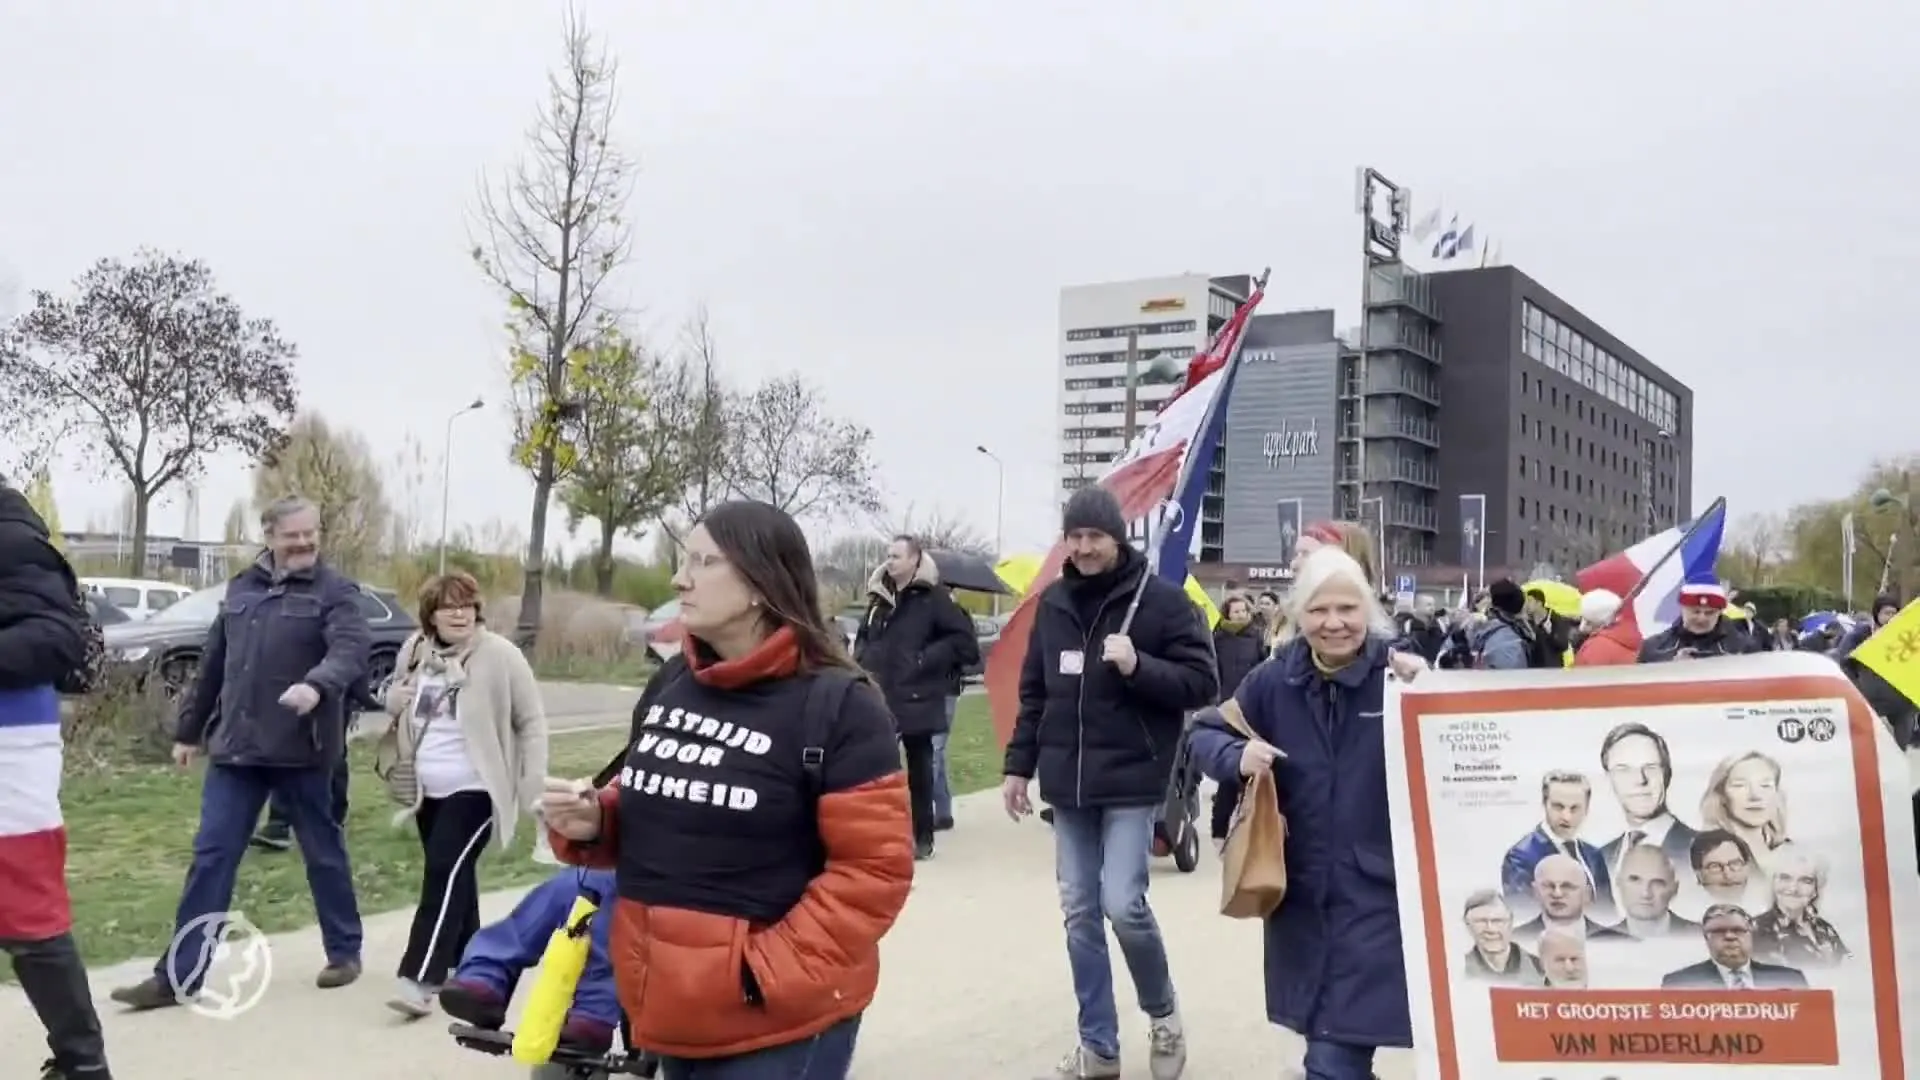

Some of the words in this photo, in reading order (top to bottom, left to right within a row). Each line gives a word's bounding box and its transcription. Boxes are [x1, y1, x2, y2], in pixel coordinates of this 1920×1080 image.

[1400, 576, 1411, 590] P
[665, 707, 772, 755] STRIJD
[1448, 721, 1498, 732] WORLD
[1439, 731, 1513, 743] ECONOMIC
[637, 733, 724, 767] VOOR
[1451, 743, 1502, 753] FORUM
[620, 766, 758, 811] RIJHEID
[1517, 1002, 1549, 1018] HET
[1557, 1002, 1651, 1020] GROOTSTE
[1659, 1002, 1800, 1021] SLOOPBEDRIJF
[1551, 1033, 1596, 1055] VAN
[1609, 1032, 1764, 1057] NEDERLAND
